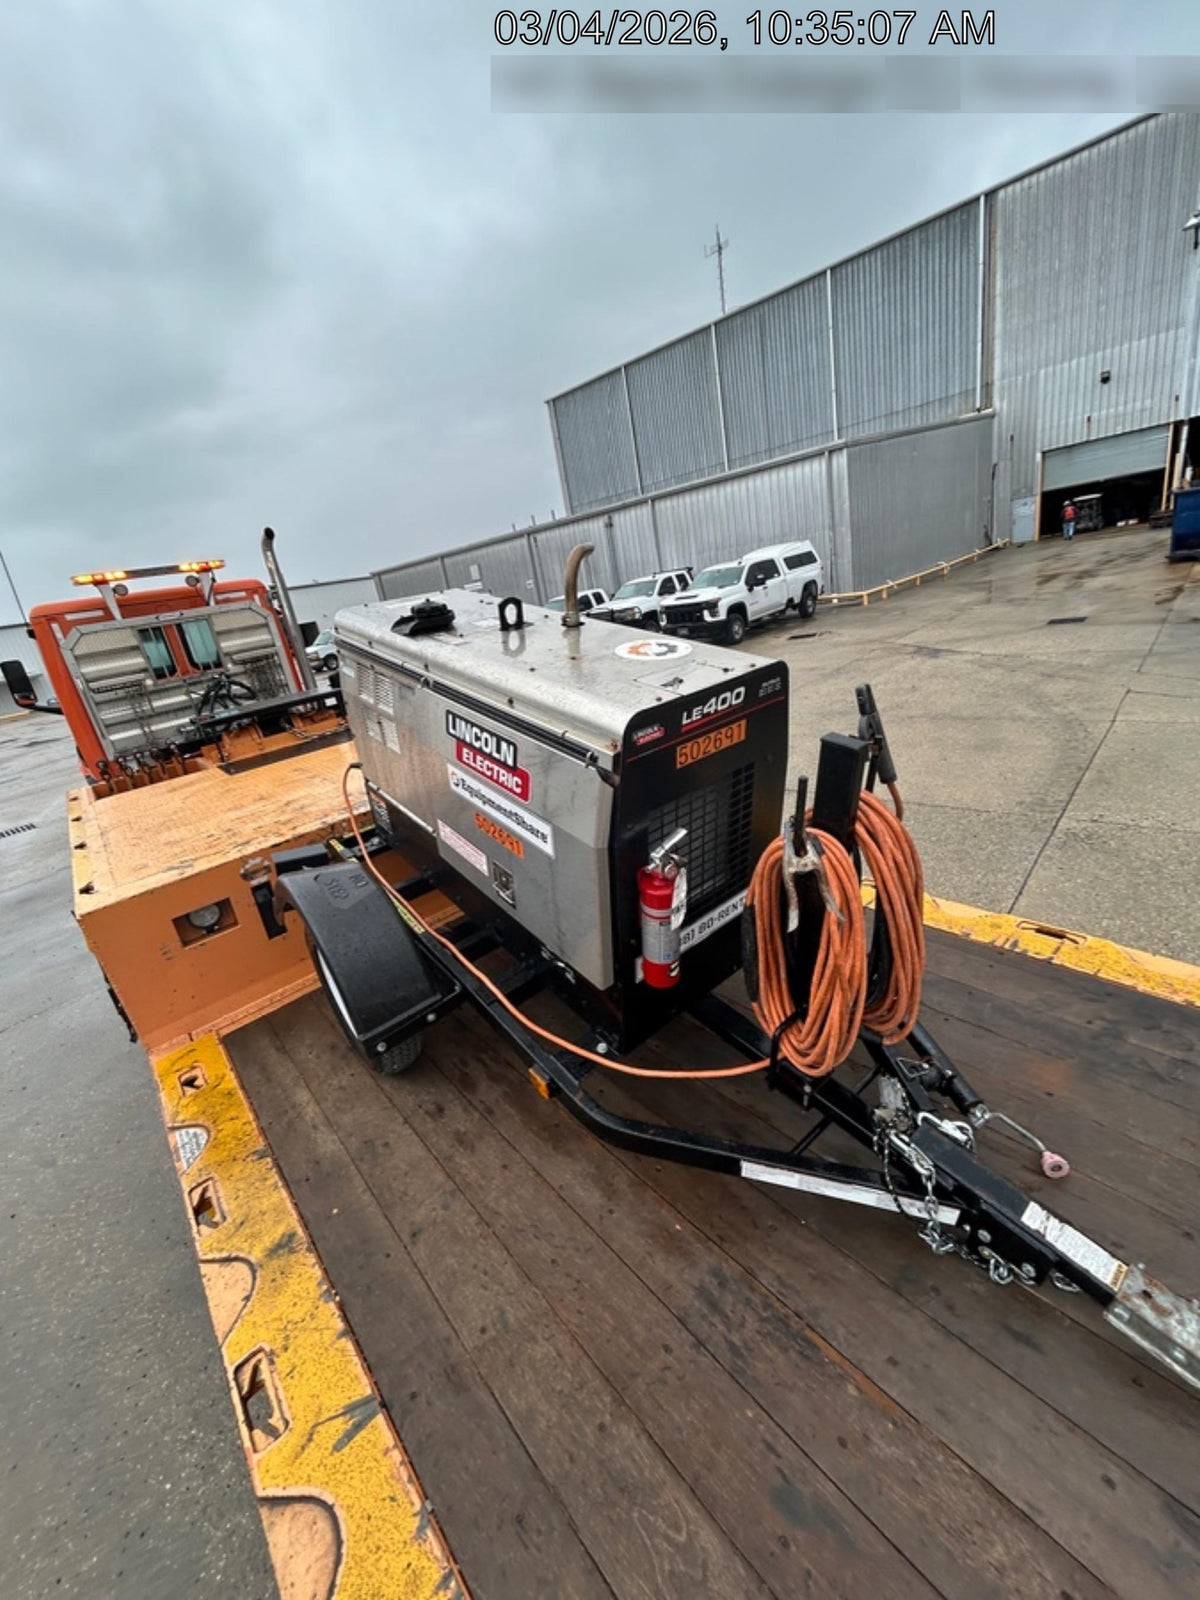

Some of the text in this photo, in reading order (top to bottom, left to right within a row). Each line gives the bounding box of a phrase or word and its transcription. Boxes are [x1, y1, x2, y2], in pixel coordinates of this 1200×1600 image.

[682, 686, 745, 725] LE400
[448, 713, 515, 768] LINCOLN
[678, 724, 743, 766] 502691
[462, 747, 523, 794] ELECTRIC
[459, 777, 549, 844] EquipmentShare
